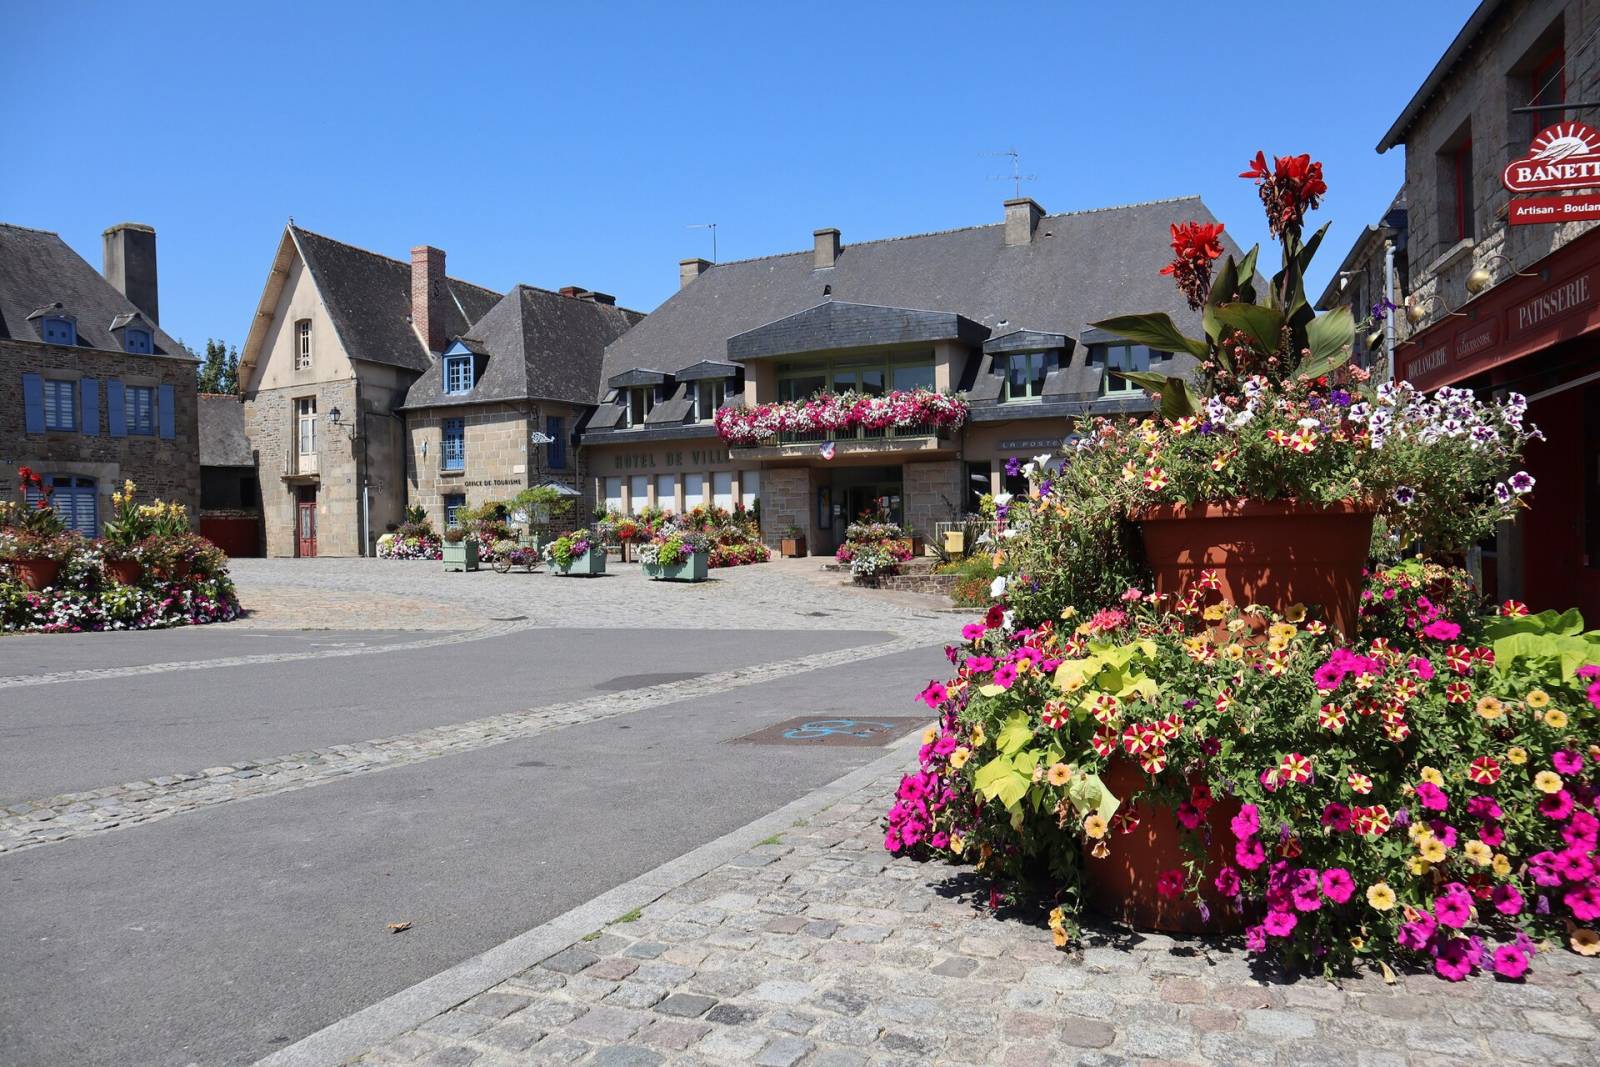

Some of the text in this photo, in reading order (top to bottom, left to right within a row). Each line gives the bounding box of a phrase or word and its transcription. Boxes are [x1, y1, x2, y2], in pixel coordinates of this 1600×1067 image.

[1516, 205, 1554, 216] Artisan
[1519, 275, 1591, 329] PATISSERIE
[665, 451, 683, 466] DE
[493, 478, 522, 486] TOURISME
